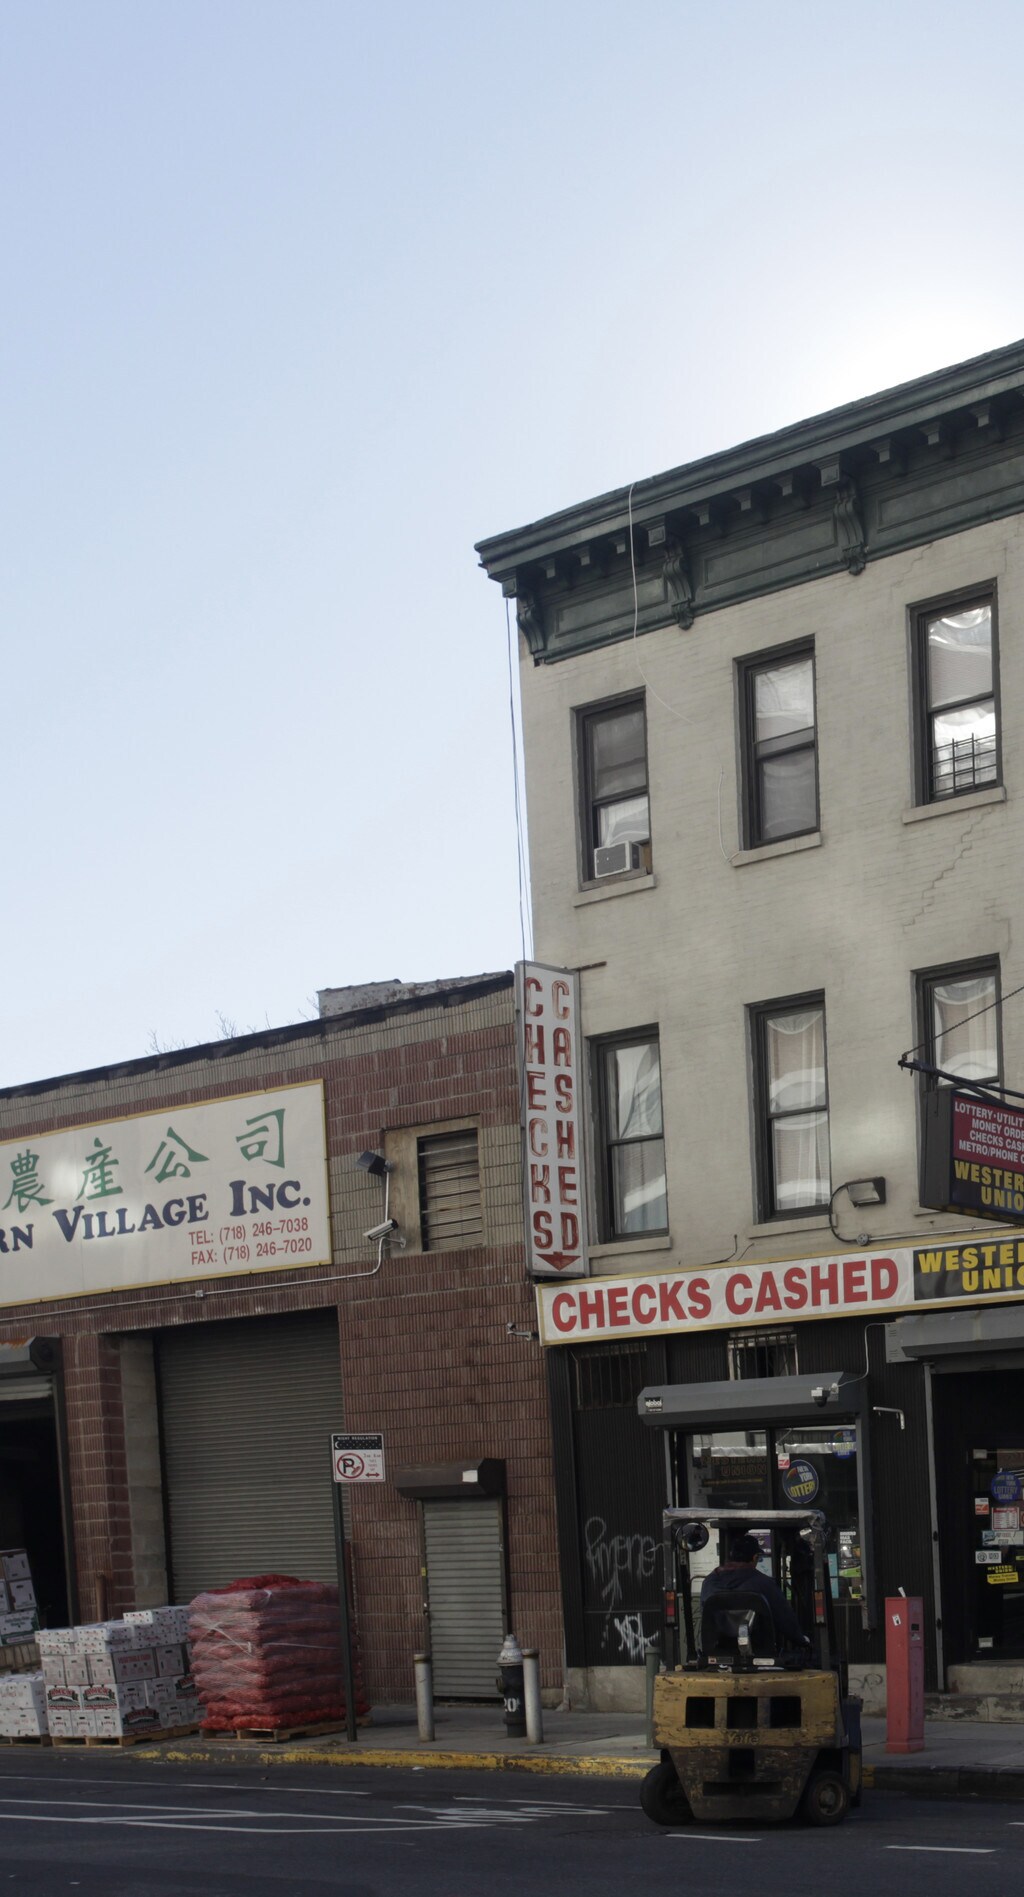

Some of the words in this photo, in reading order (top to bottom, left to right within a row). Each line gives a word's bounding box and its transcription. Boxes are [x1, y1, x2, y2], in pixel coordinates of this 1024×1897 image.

[524, 976, 553, 1250] CHECKS
[552, 979, 579, 1251] CASHED
[972, 1118, 1002, 1134] MONEY
[959, 1140, 1019, 1163] METRO/PHONE
[969, 1131, 1004, 1148] CHECKS
[52, 1193, 210, 1243] VILLAGE
[229, 1179, 312, 1217] INC.
[189, 1231, 214, 1246] TEL:
[219, 1224, 247, 1245] (718)
[252, 1217, 309, 1239] 246-7038
[191, 1250, 218, 1266] FAX:
[222, 1244, 250, 1265] (718)
[256, 1236, 312, 1258] 246-7020
[552, 1277, 712, 1332] CHECKS
[725, 1257, 899, 1315] CASHED
[727, 1730, 760, 1745] Yale
